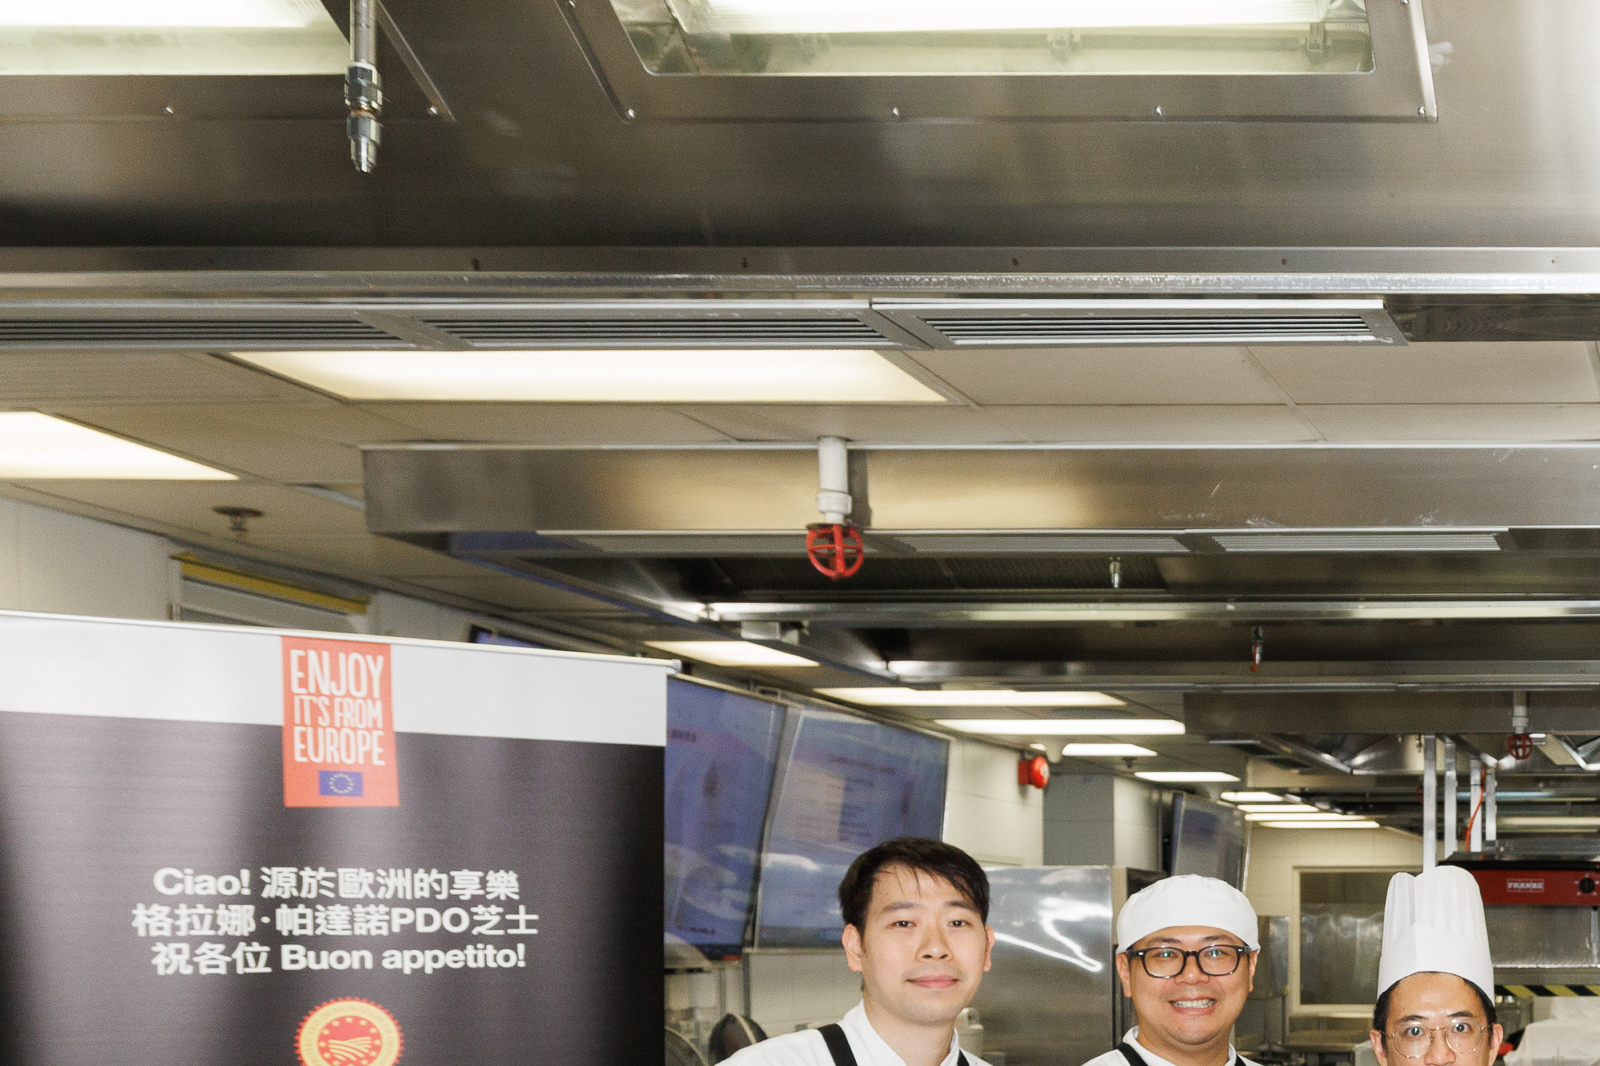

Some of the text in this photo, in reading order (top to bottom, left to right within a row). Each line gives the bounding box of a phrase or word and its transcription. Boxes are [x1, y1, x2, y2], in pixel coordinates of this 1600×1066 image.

[290, 649, 384, 699] ENJOY
[294, 695, 382, 729] IT'S FROM
[294, 726, 386, 766] EUROPE
[153, 866, 520, 900] Ciao! 源於歐洲的享樂
[151, 941, 527, 975] 祝各位 Buon appetito!
